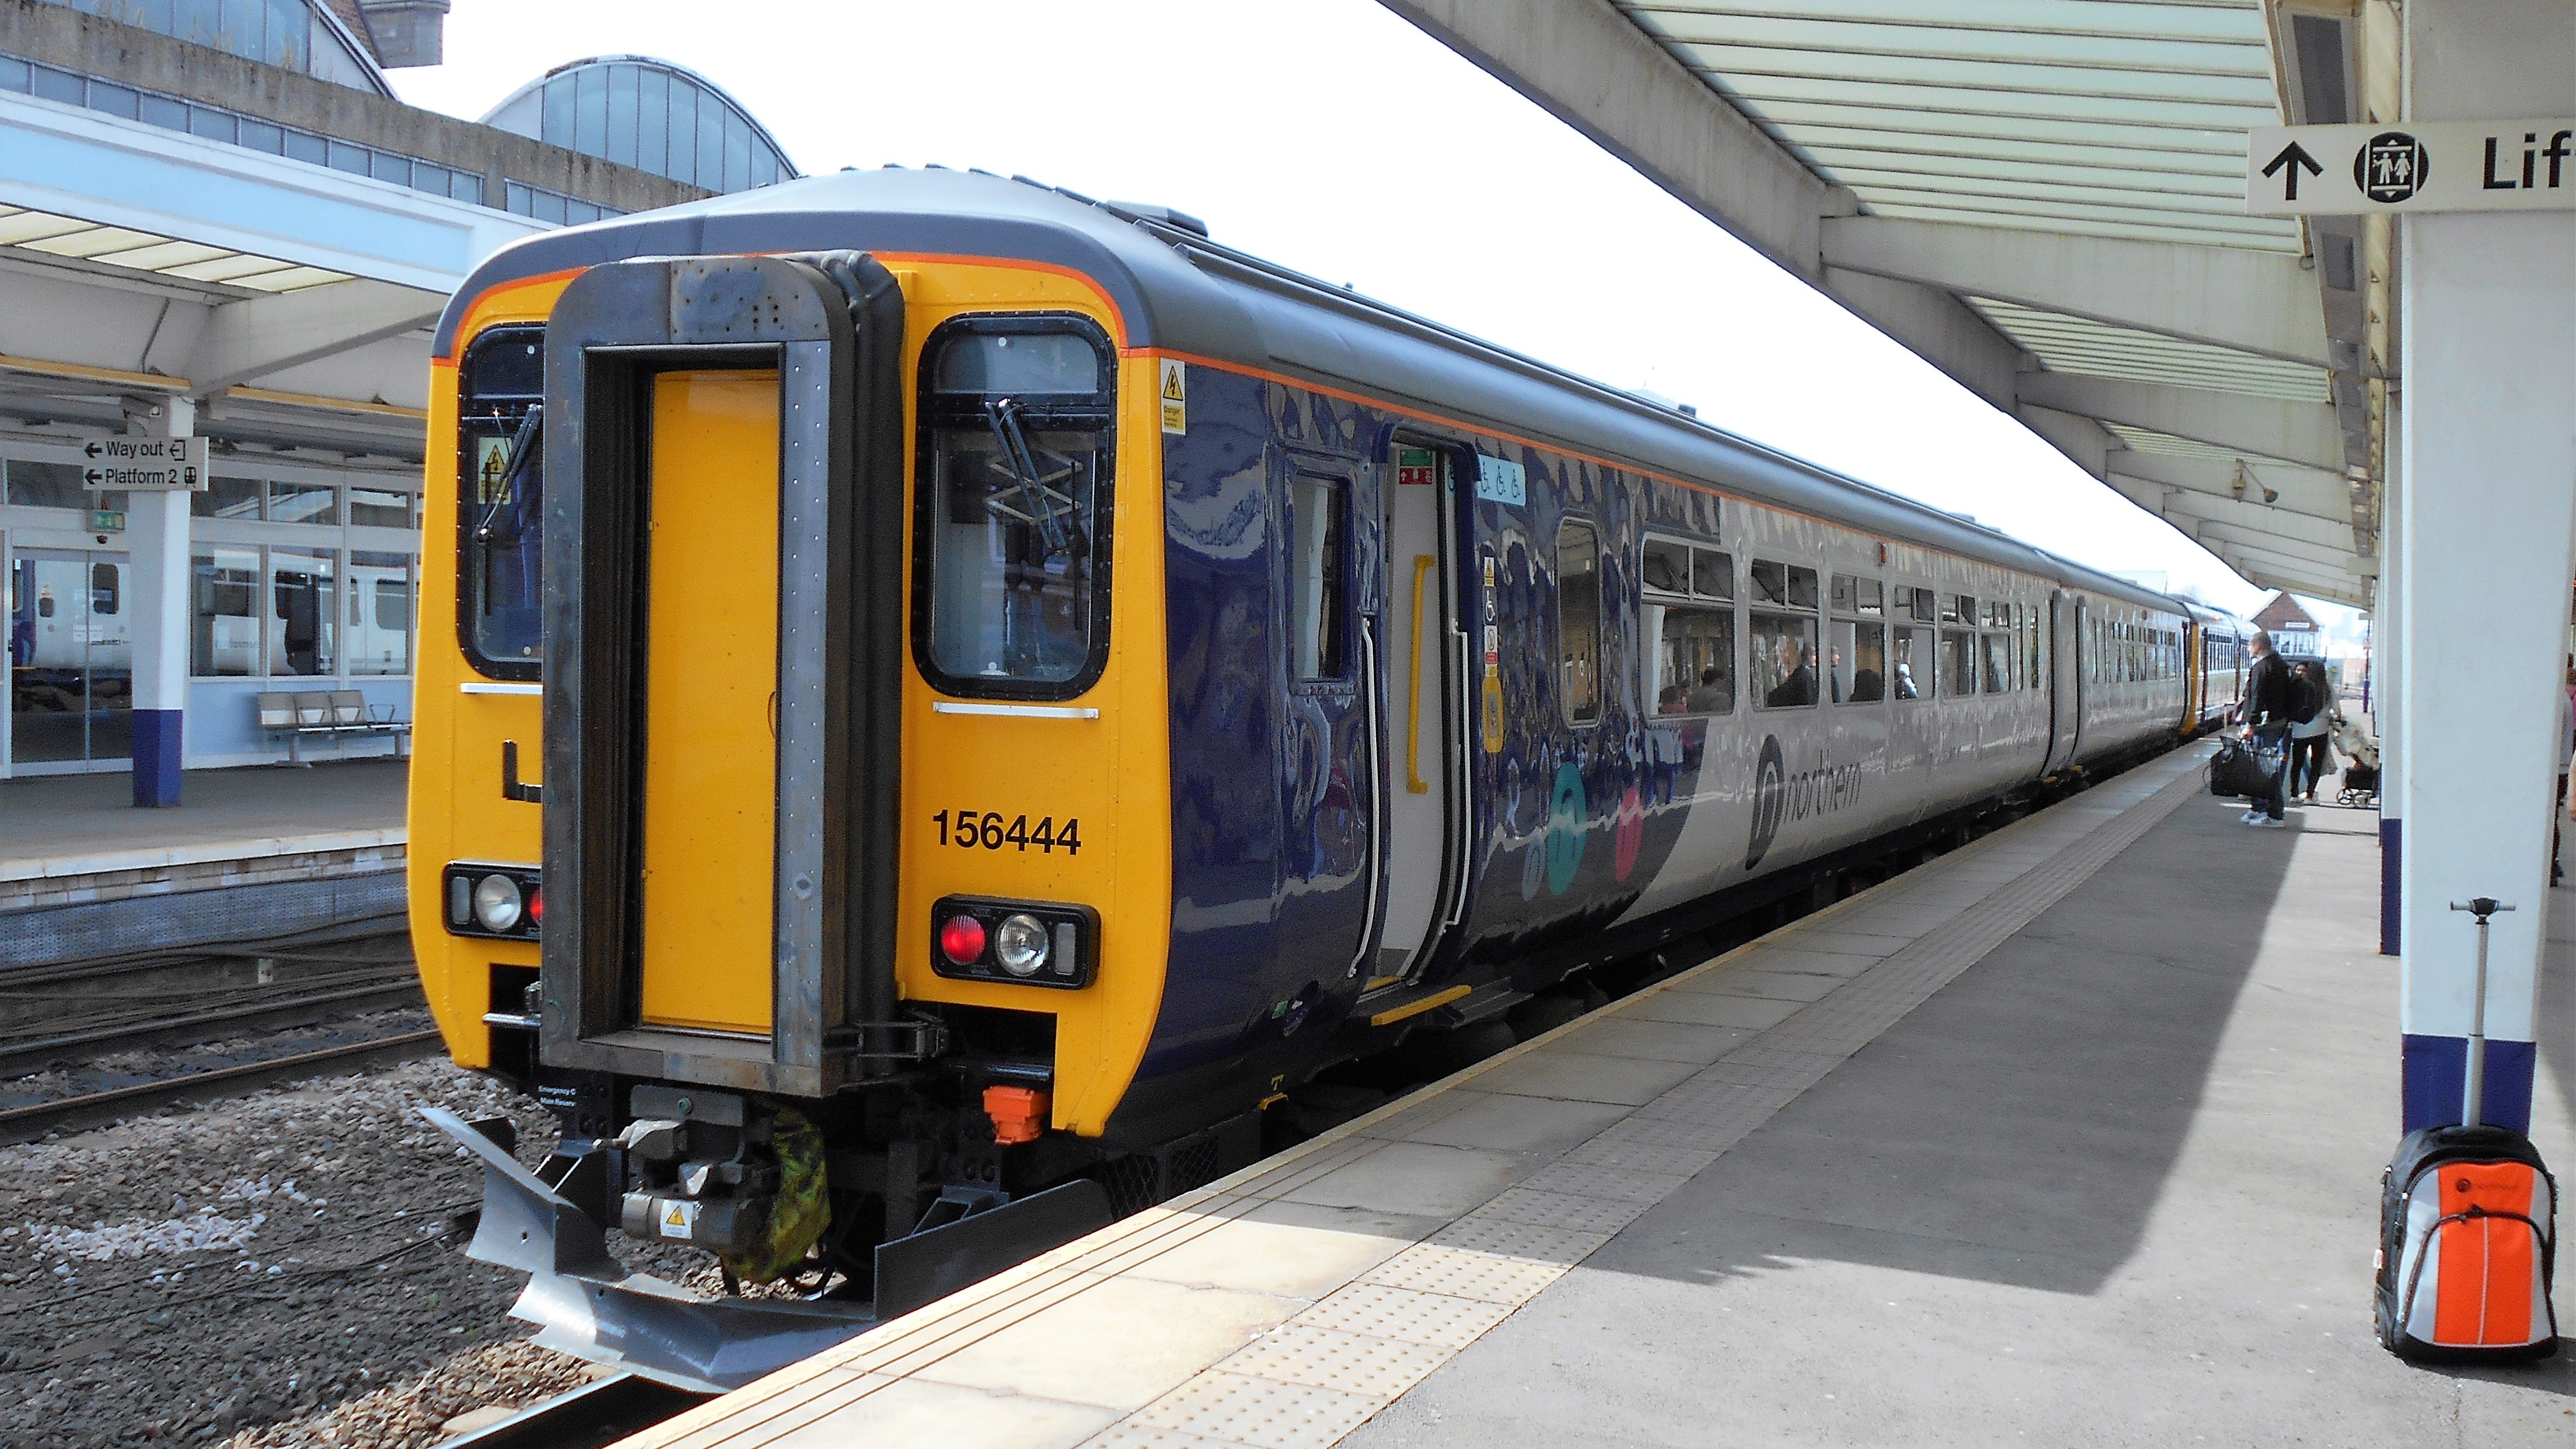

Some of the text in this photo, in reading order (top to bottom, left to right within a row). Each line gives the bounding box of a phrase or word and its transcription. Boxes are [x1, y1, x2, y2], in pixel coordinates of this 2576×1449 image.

[2483, 129, 2576, 189] Lif
[106, 441, 163, 458] Way out
[106, 468, 177, 484] Platform 2
[1783, 748, 1861, 825] northern
[933, 809, 1081, 855] 156444
